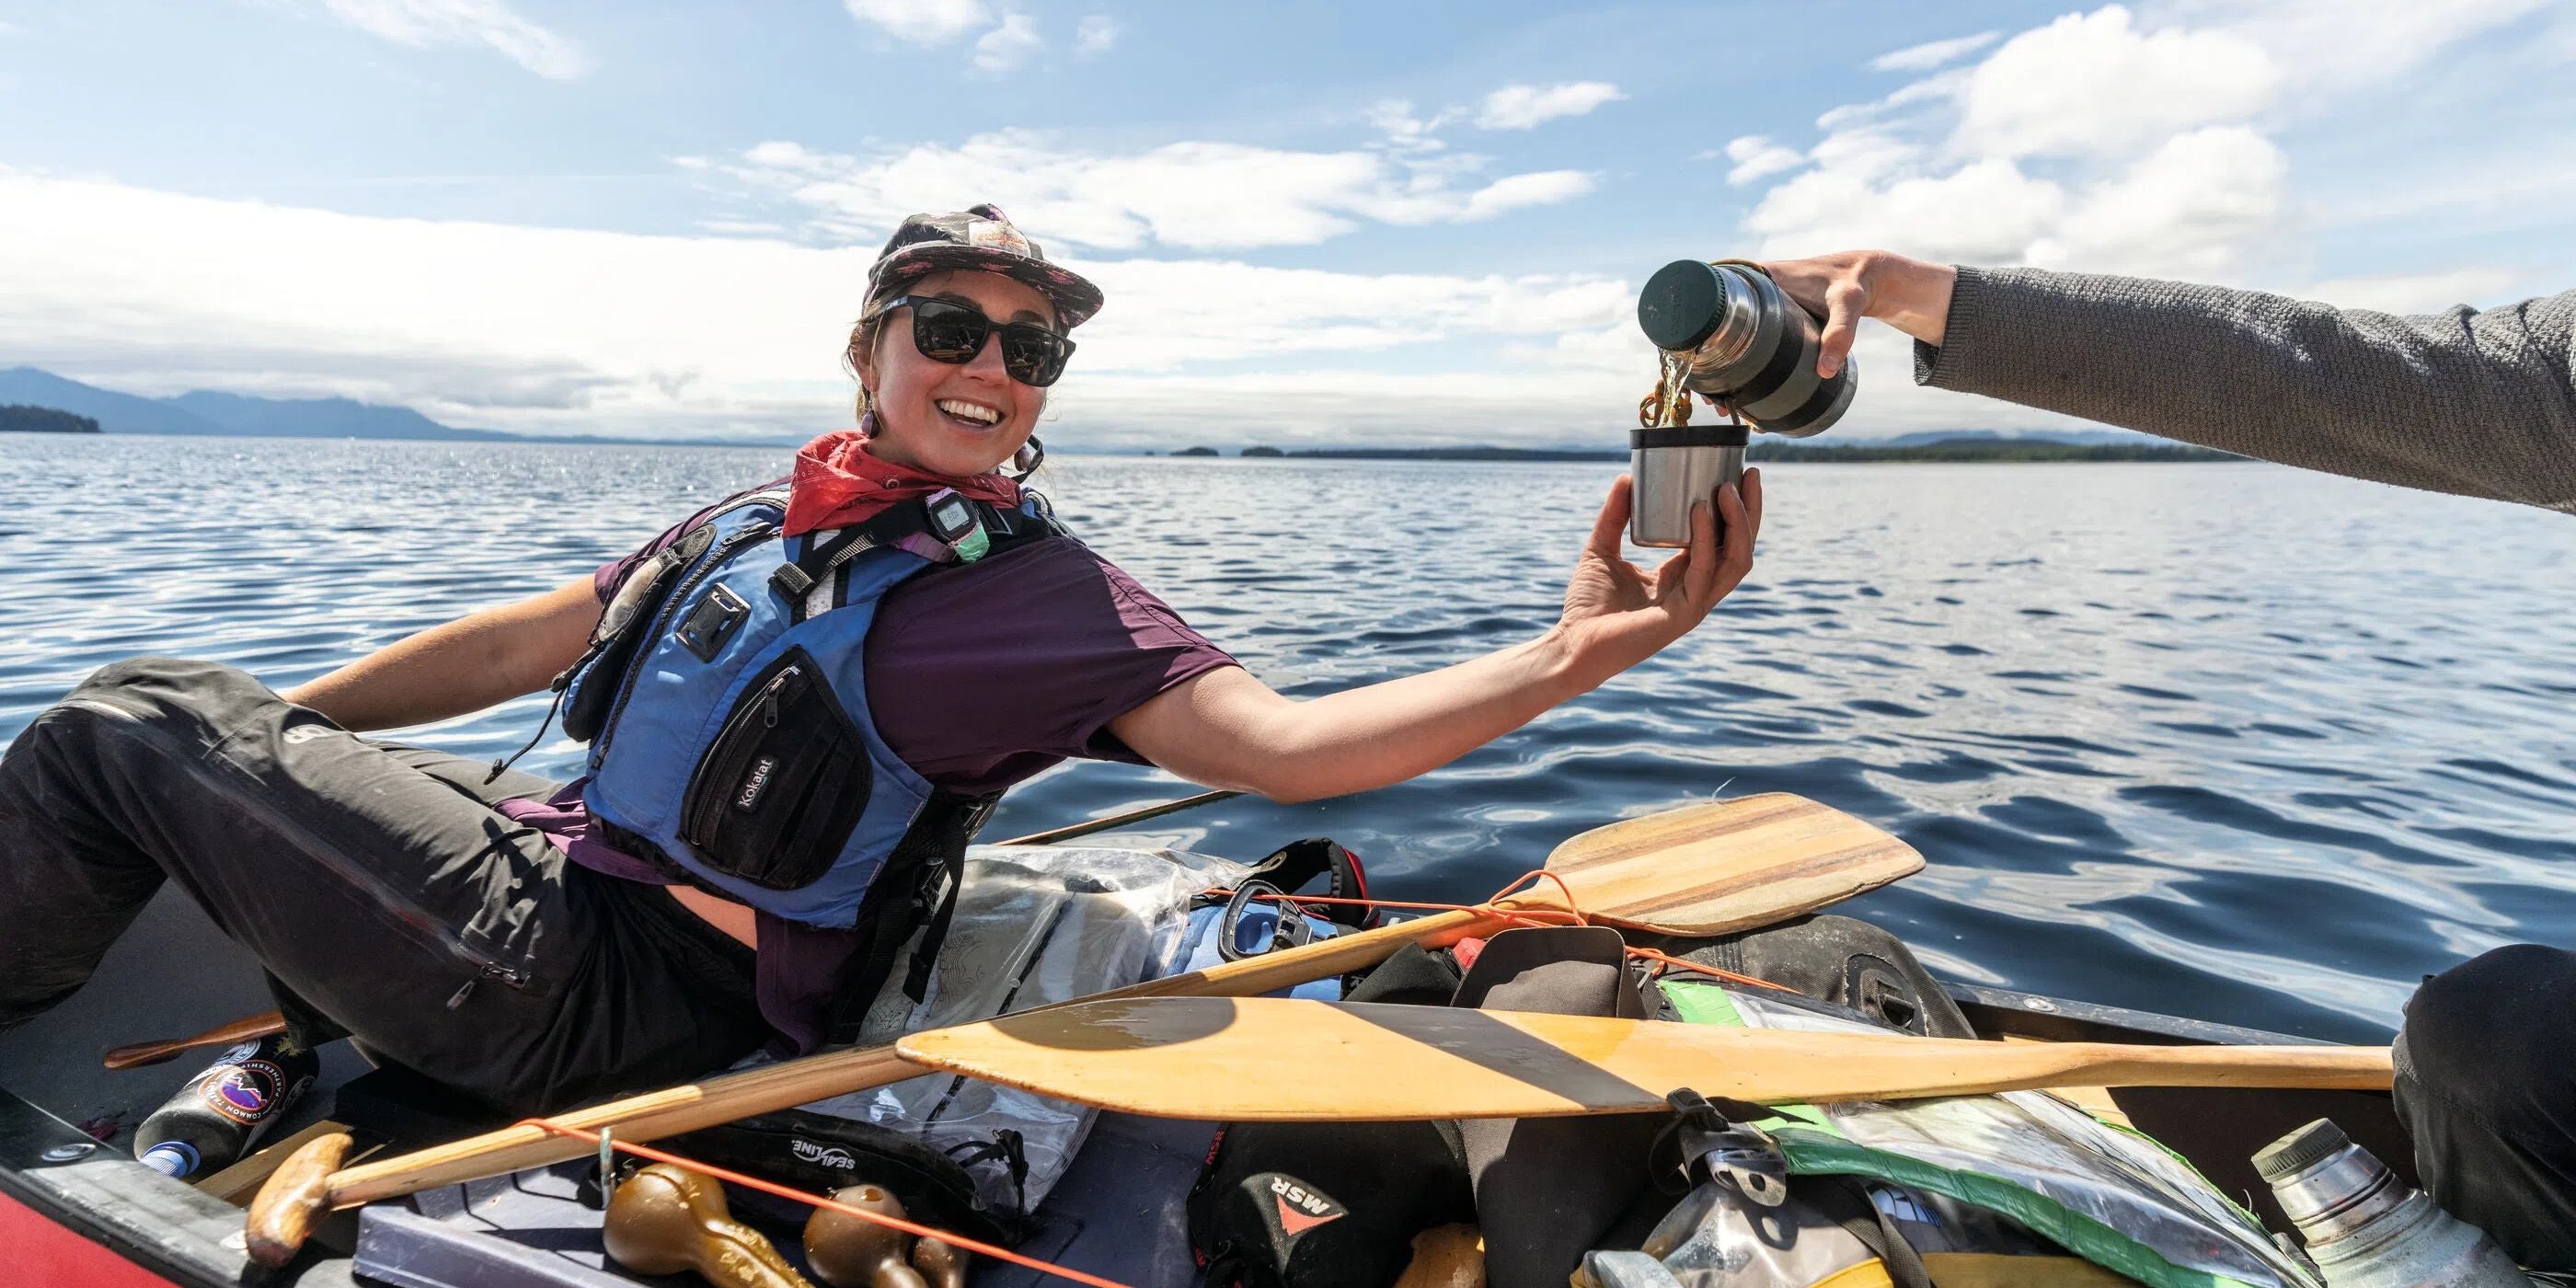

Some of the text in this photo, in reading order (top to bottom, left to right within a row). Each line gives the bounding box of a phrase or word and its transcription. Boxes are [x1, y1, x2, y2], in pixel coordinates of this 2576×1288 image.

[739, 759, 773, 807] Kokatat
[240, 1063, 282, 1098] PARTNERSHIP
[225, 1106, 261, 1121] COMMON
[1271, 1177, 1330, 1214] MSR
